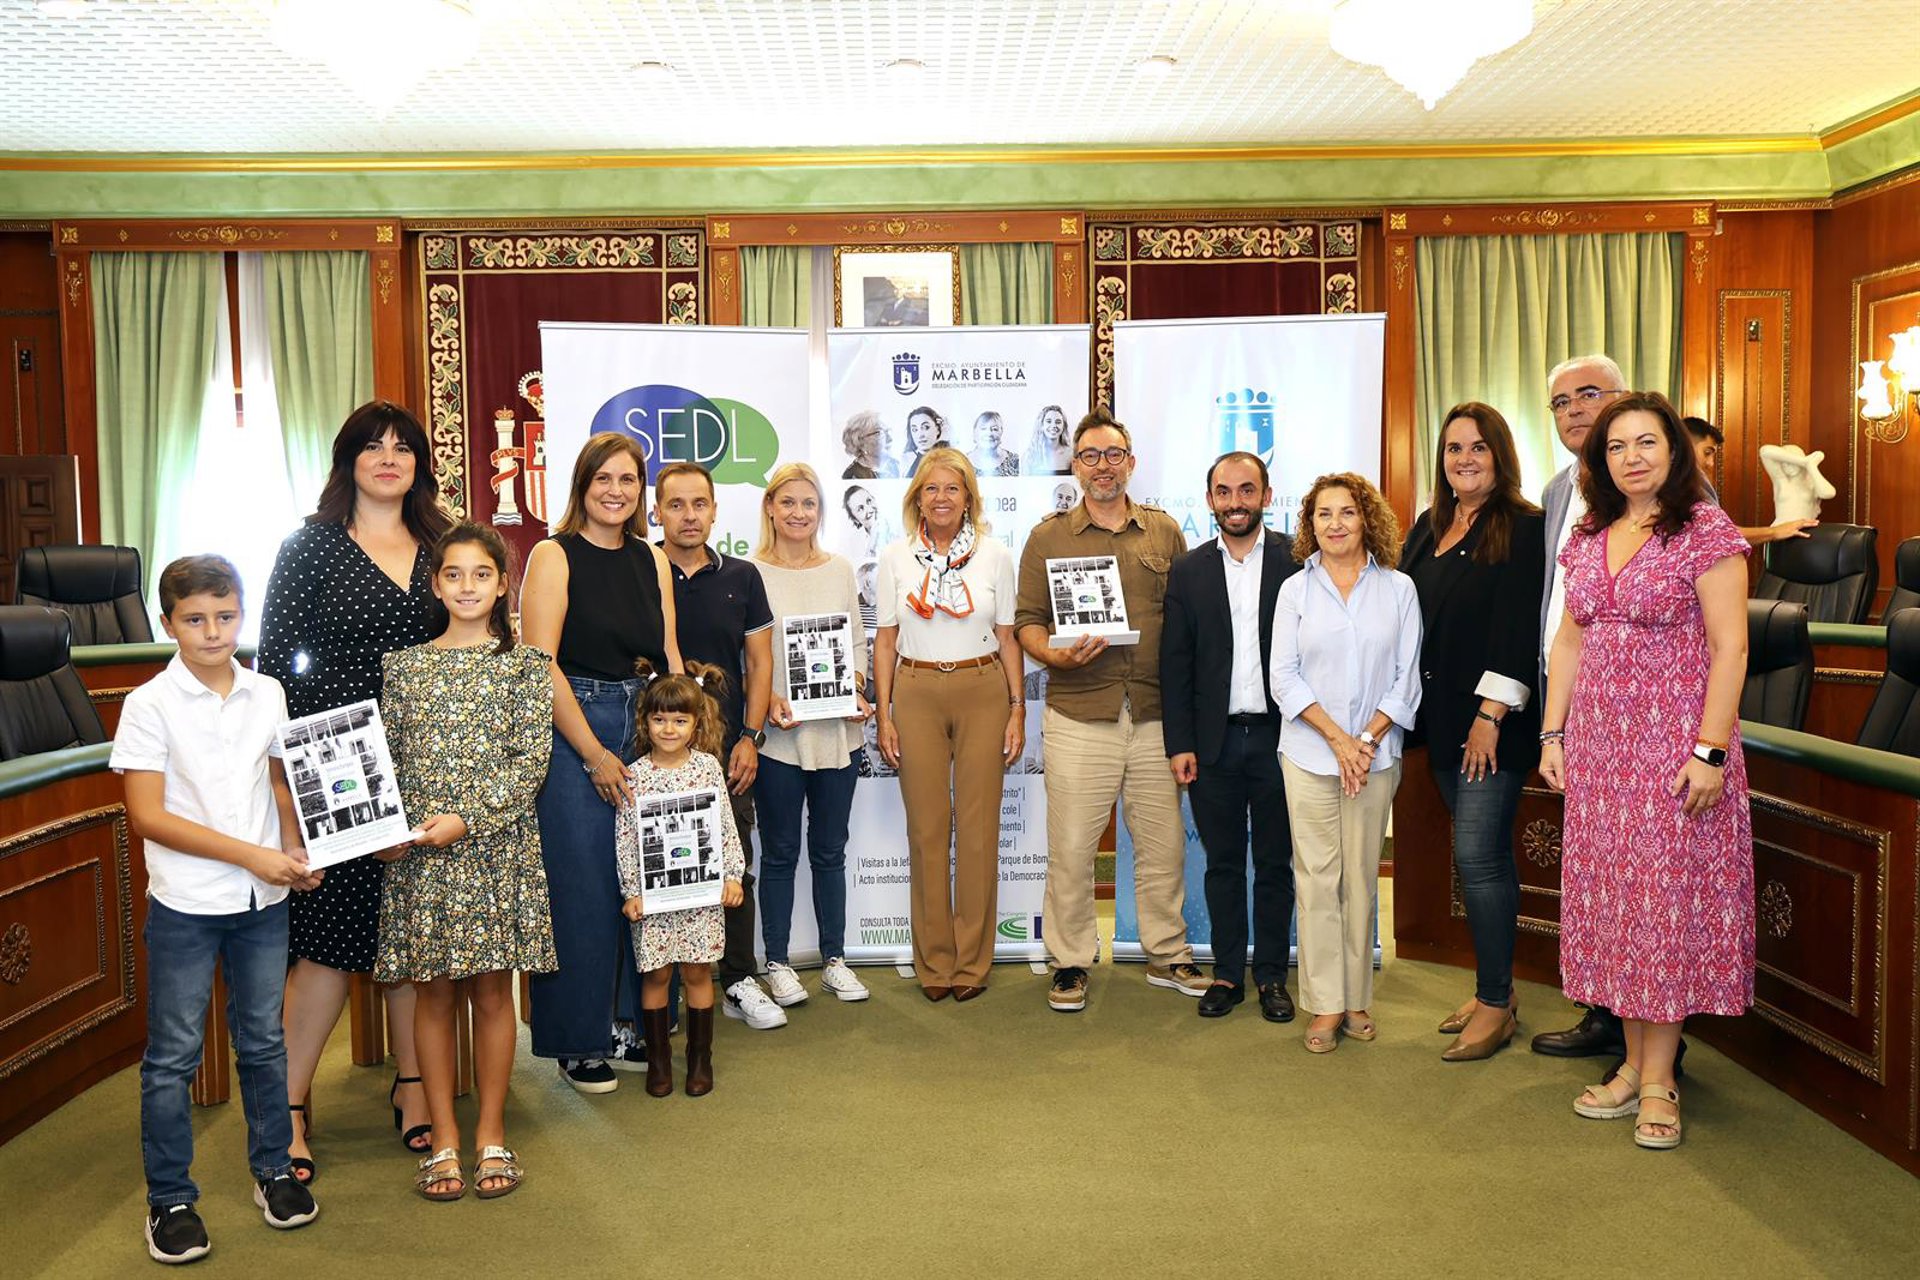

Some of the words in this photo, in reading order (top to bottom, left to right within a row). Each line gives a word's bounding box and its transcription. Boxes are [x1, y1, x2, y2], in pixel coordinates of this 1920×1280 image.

[931, 368, 1026, 381] MARBELLA
[624, 407, 757, 464] SEDL
[716, 532, 750, 556] de
[1002, 804, 1017, 815] cole
[861, 858, 884, 868] Visitas
[886, 860, 890, 868] a
[891, 857, 898, 867] la
[1022, 854, 1032, 865] de
[1033, 853, 1048, 864] Bom
[859, 875, 875, 885] Acto
[1002, 871, 1009, 880] la
[1010, 870, 1047, 880] Democraci
[860, 918, 892, 928] CONSULTA
[893, 917, 909, 927] TODA
[861, 930, 911, 944] WWW.MA
